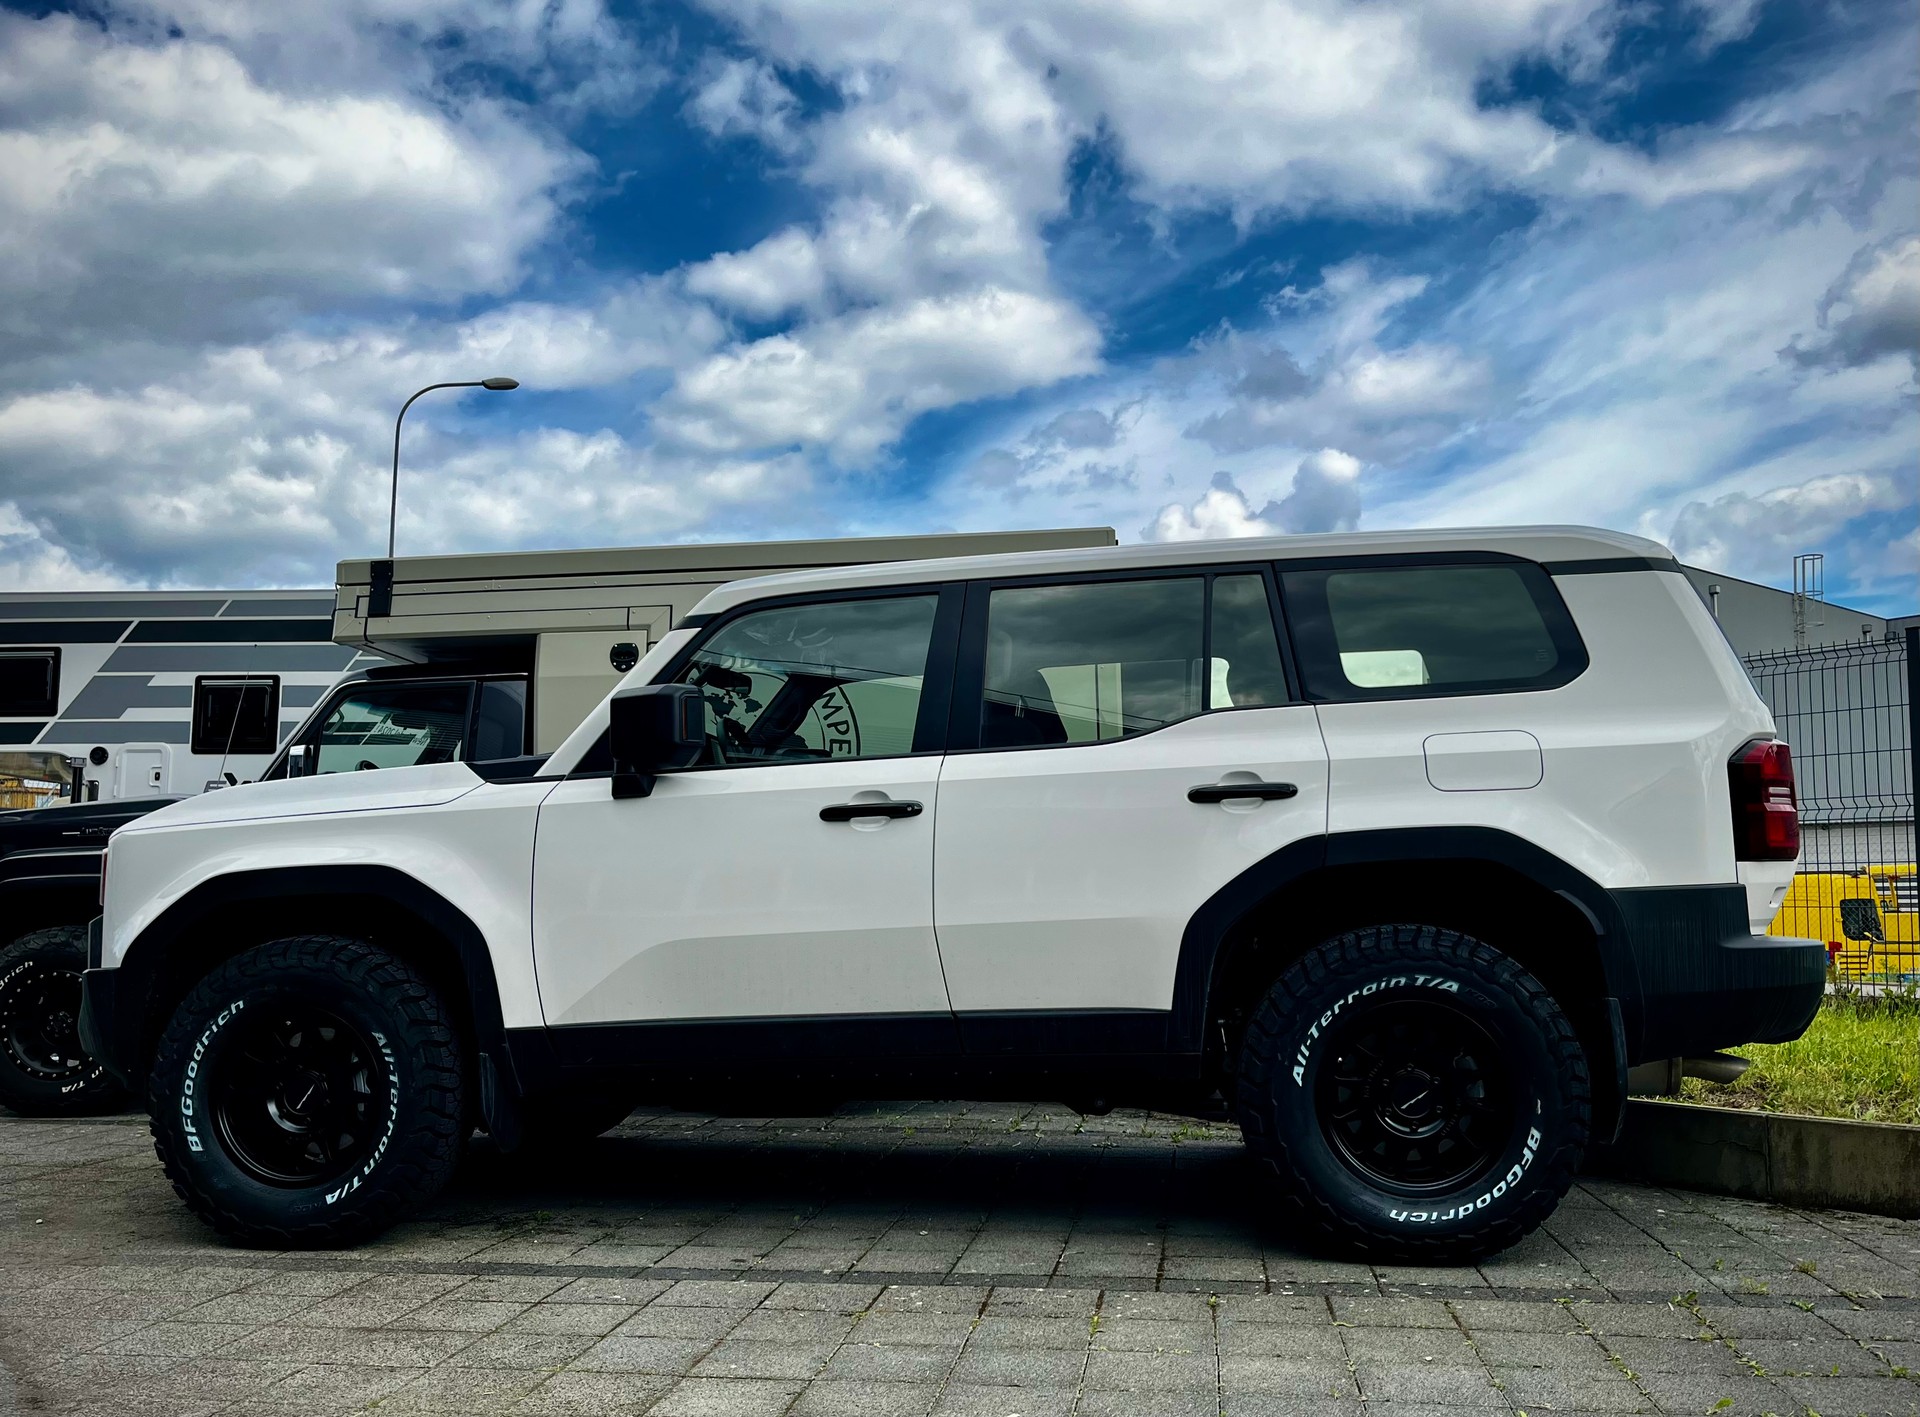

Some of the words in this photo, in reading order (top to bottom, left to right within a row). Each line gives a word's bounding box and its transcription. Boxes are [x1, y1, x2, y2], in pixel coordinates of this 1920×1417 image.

[181, 1000, 245, 1152] BFGoodrich
[1292, 976, 1406, 1087] All-Terrain
[1414, 974, 1460, 993] T/A
[363, 1031, 400, 1176] All-Terrain
[324, 1176, 363, 1205] T/A
[1389, 1126, 1542, 1224] BFGoodrich
